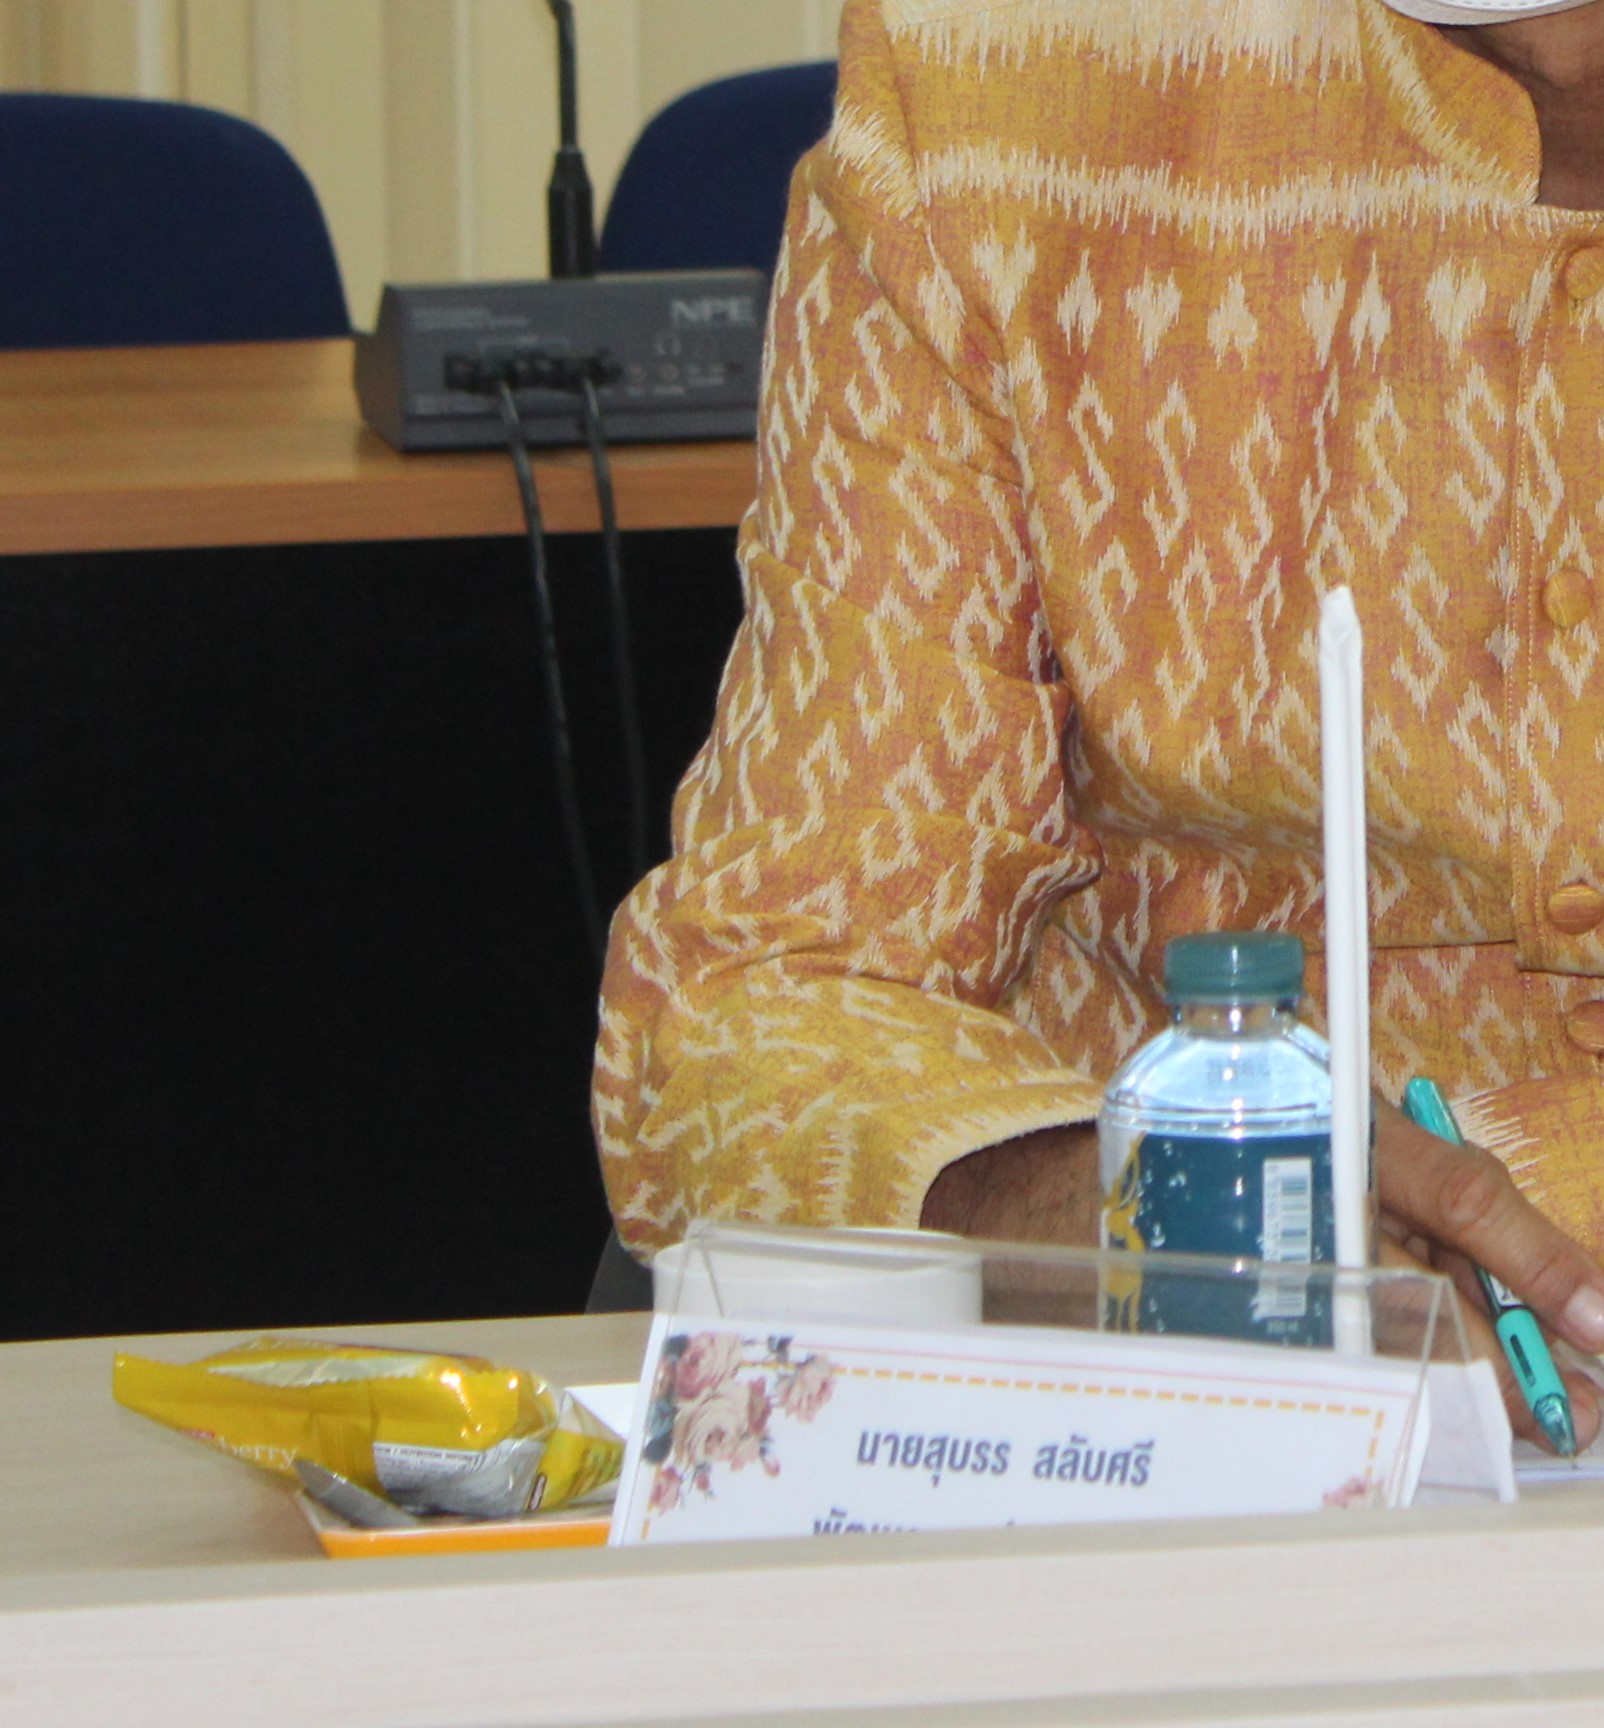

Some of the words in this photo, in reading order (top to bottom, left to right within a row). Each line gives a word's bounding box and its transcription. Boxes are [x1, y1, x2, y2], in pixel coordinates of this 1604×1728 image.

[671, 297, 756, 326] NPE
[857, 1428, 1011, 1489] นายสุบรร
[1033, 1432, 1156, 1488] สลับศรี
